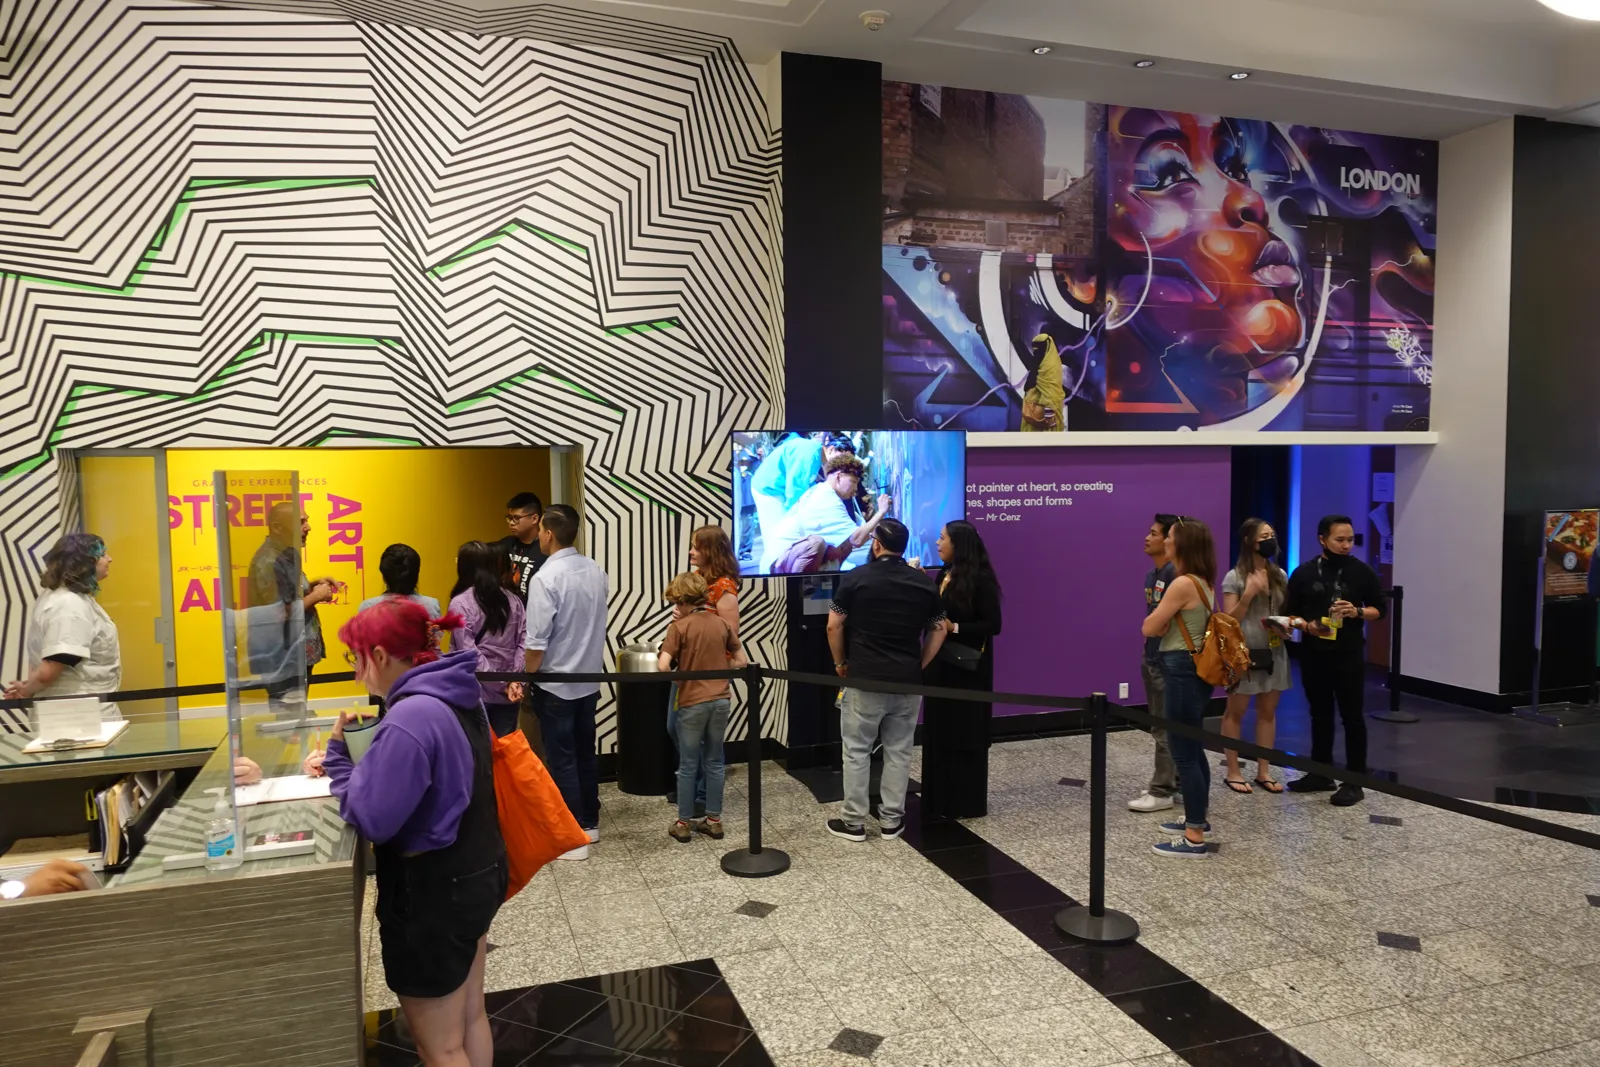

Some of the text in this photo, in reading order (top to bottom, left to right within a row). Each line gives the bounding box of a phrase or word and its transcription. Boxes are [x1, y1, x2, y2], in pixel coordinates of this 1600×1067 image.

[1340, 166, 1420, 195] LONDON
[192, 479, 245, 487] GRADE
[966, 481, 1113, 495] ct painter at heart, so creating
[966, 496, 1073, 509] nes, shapes and forms
[986, 513, 997, 521] Mr
[1000, 512, 1021, 521] Cenz
[327, 493, 365, 573] ART
